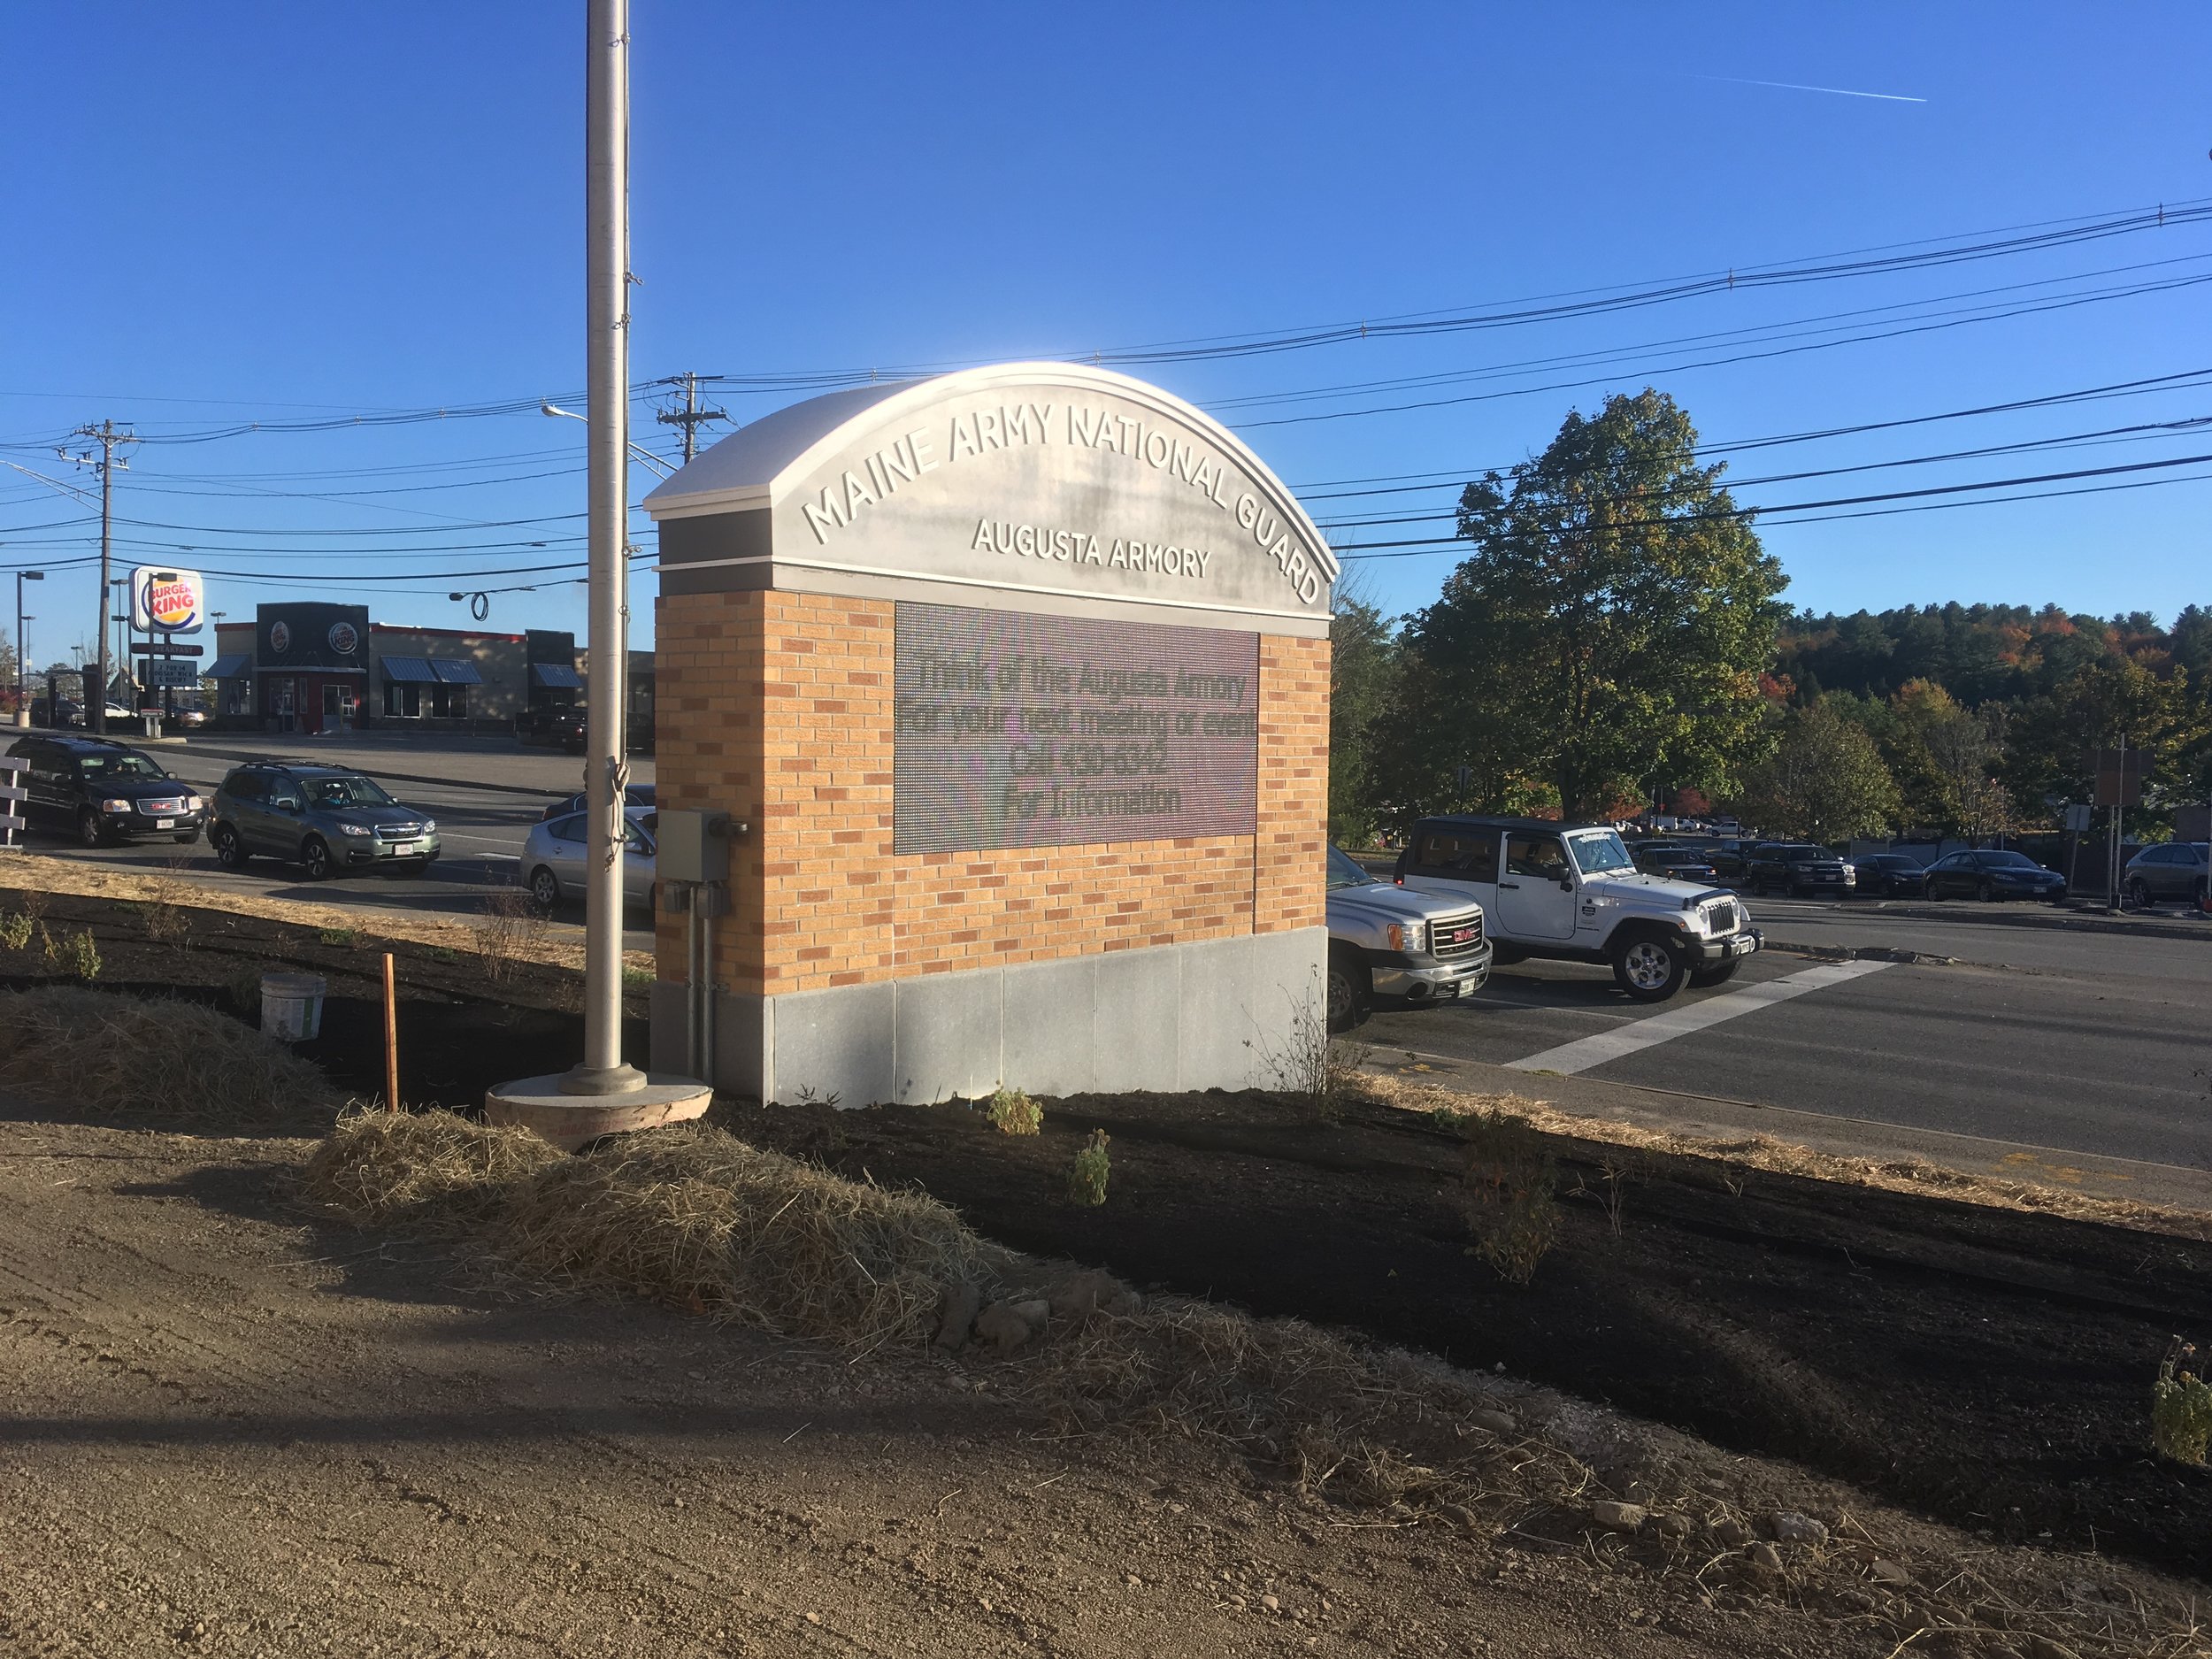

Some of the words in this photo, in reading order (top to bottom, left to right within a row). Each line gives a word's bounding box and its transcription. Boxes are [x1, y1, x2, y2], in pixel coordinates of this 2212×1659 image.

[801, 426, 940, 545] MAINE
[949, 403, 1055, 463] ARMY
[1067, 404, 1228, 511] NATIONAL
[1234, 492, 1319, 605] GUARD
[971, 518, 1102, 566] AUGUSTA
[1107, 538, 1211, 578] ARMORY
[152, 594, 194, 616] KING
[915, 651, 988, 690] Think
[997, 656, 1025, 692] of
[1032, 657, 1070, 695] the
[1077, 661, 1167, 705] Augusta
[1174, 664, 1247, 706] Armory
[895, 697, 941, 734] For
[951, 704, 1009, 741] your
[1019, 703, 1072, 734] next
[1080, 704, 1167, 741] meeting
[1175, 711, 1196, 735] or
[1008, 741, 1054, 777] Call
[1002, 787, 1043, 820] For
[1050, 782, 1181, 818] Information
[1453, 927, 1476, 942] GMC
